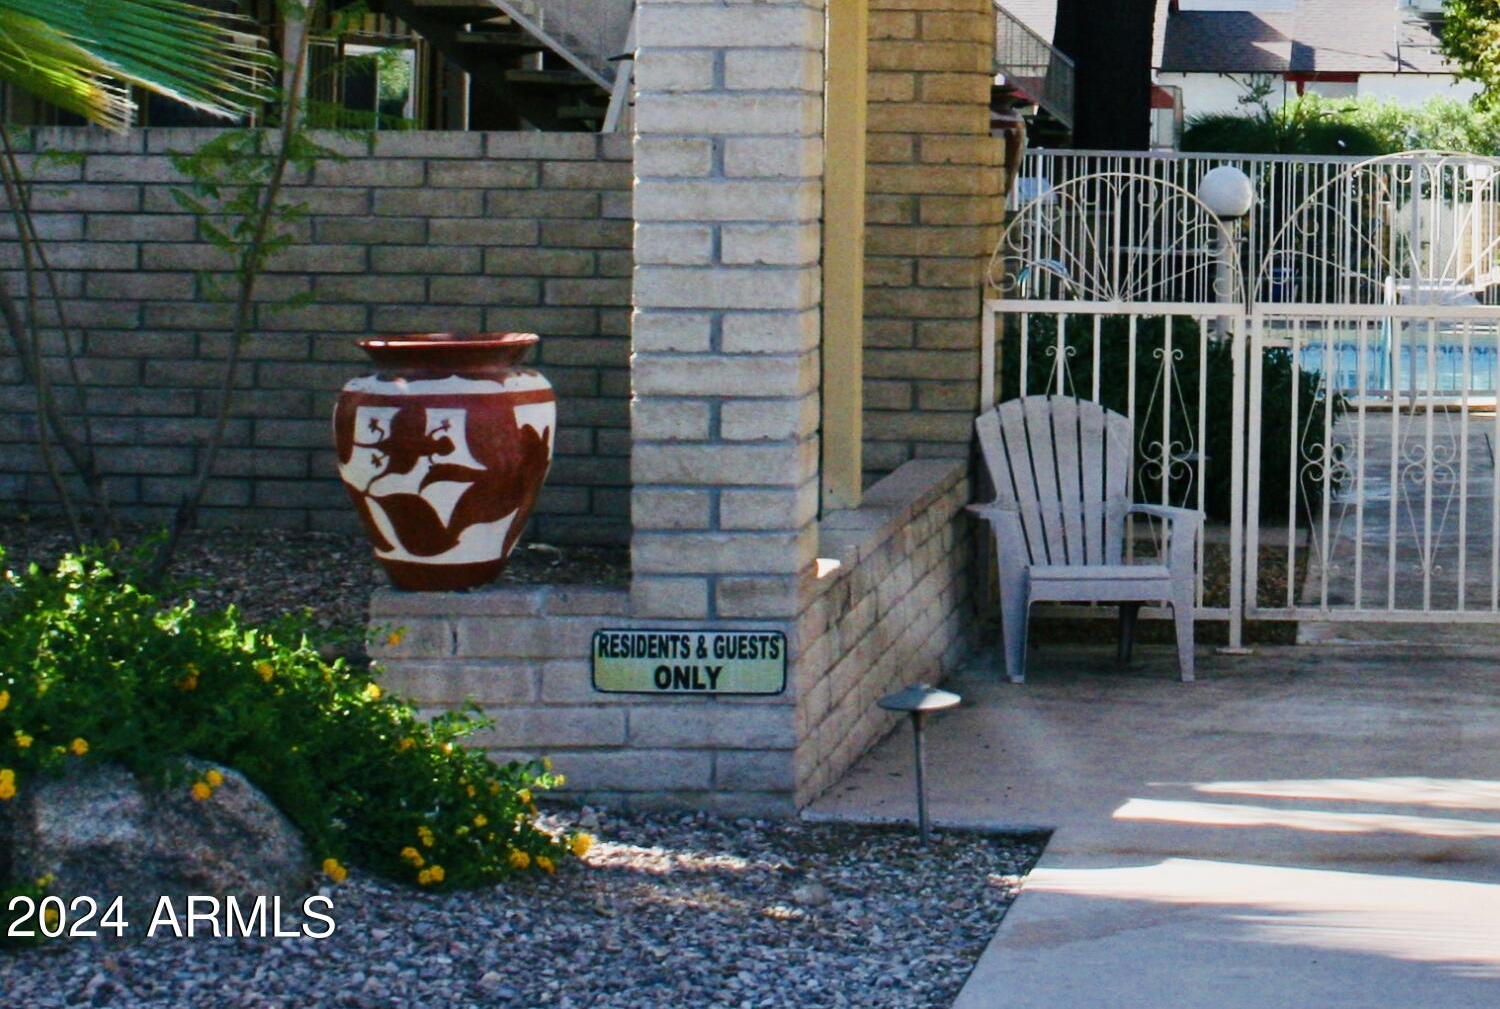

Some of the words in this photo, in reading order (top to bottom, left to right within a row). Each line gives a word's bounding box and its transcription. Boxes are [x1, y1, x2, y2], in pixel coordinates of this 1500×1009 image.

[598, 633, 690, 659] RESIDENTS
[696, 635, 708, 659] &
[713, 634, 780, 659] GUESTS
[654, 665, 722, 690] ONLY
